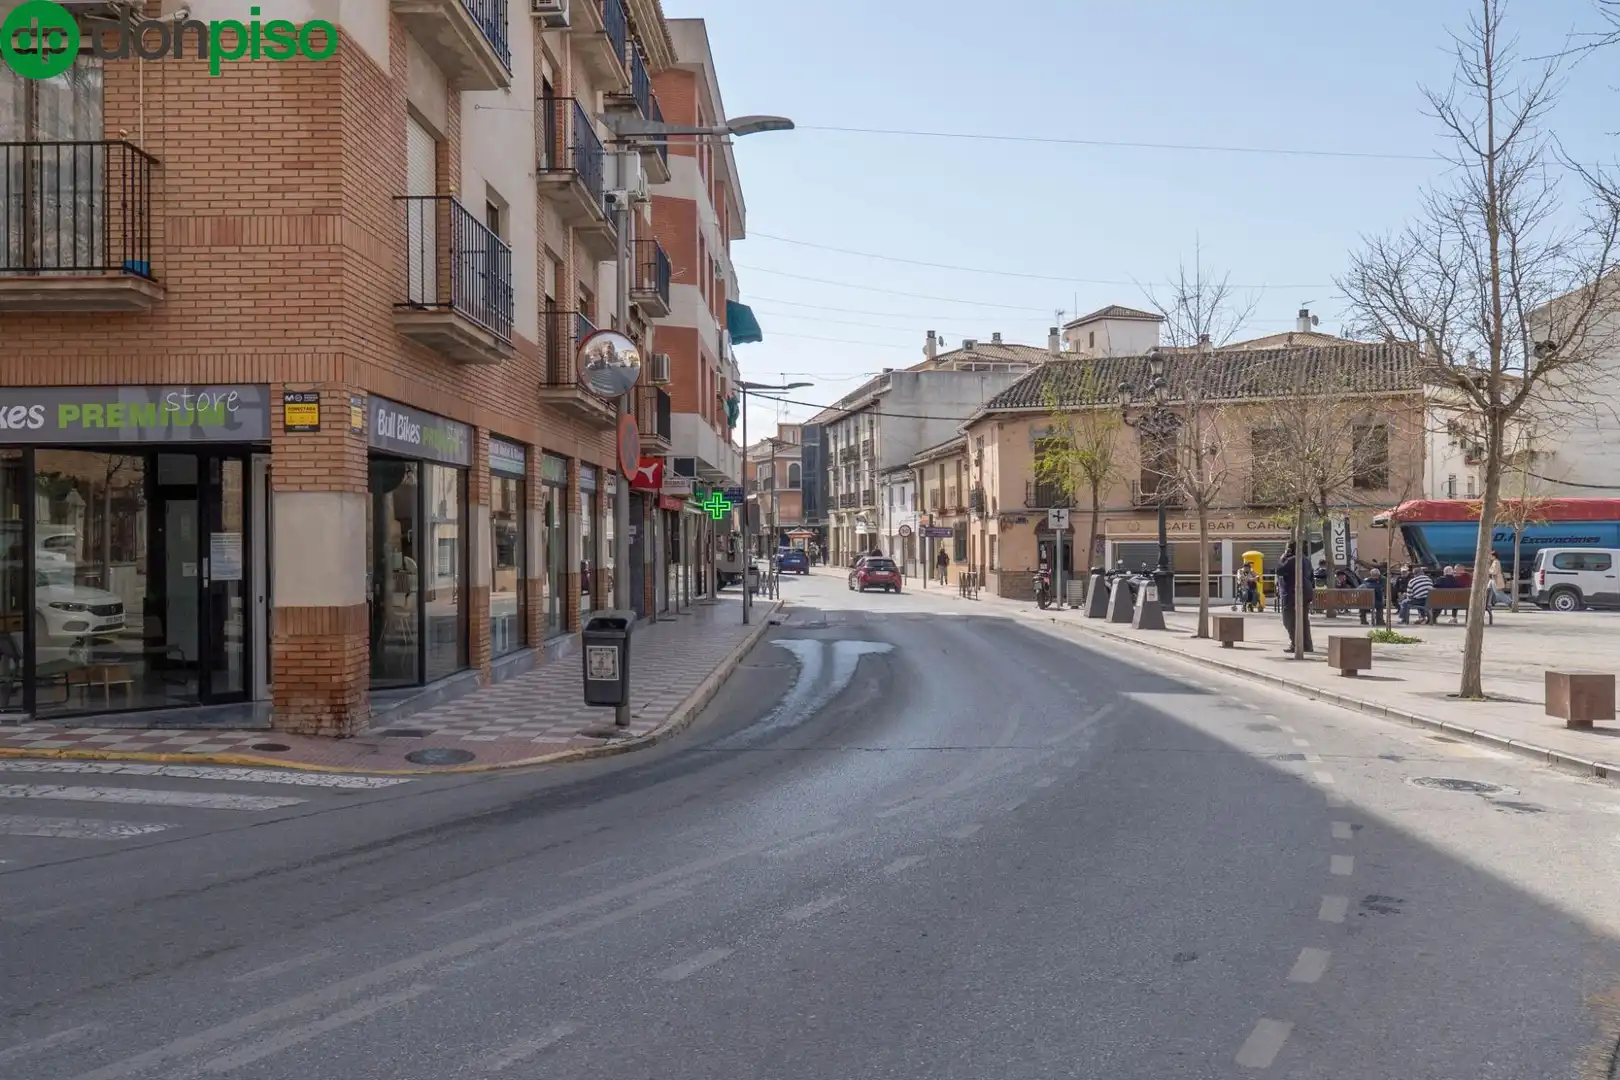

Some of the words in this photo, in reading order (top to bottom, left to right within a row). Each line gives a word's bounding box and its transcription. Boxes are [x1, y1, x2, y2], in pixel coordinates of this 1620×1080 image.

[164, 387, 240, 412] store
[58, 402, 226, 429] PREMIUM
[377, 408, 397, 438] Bull
[396, 414, 420, 445] Bikes
[1208, 521, 1234, 531] BAR
